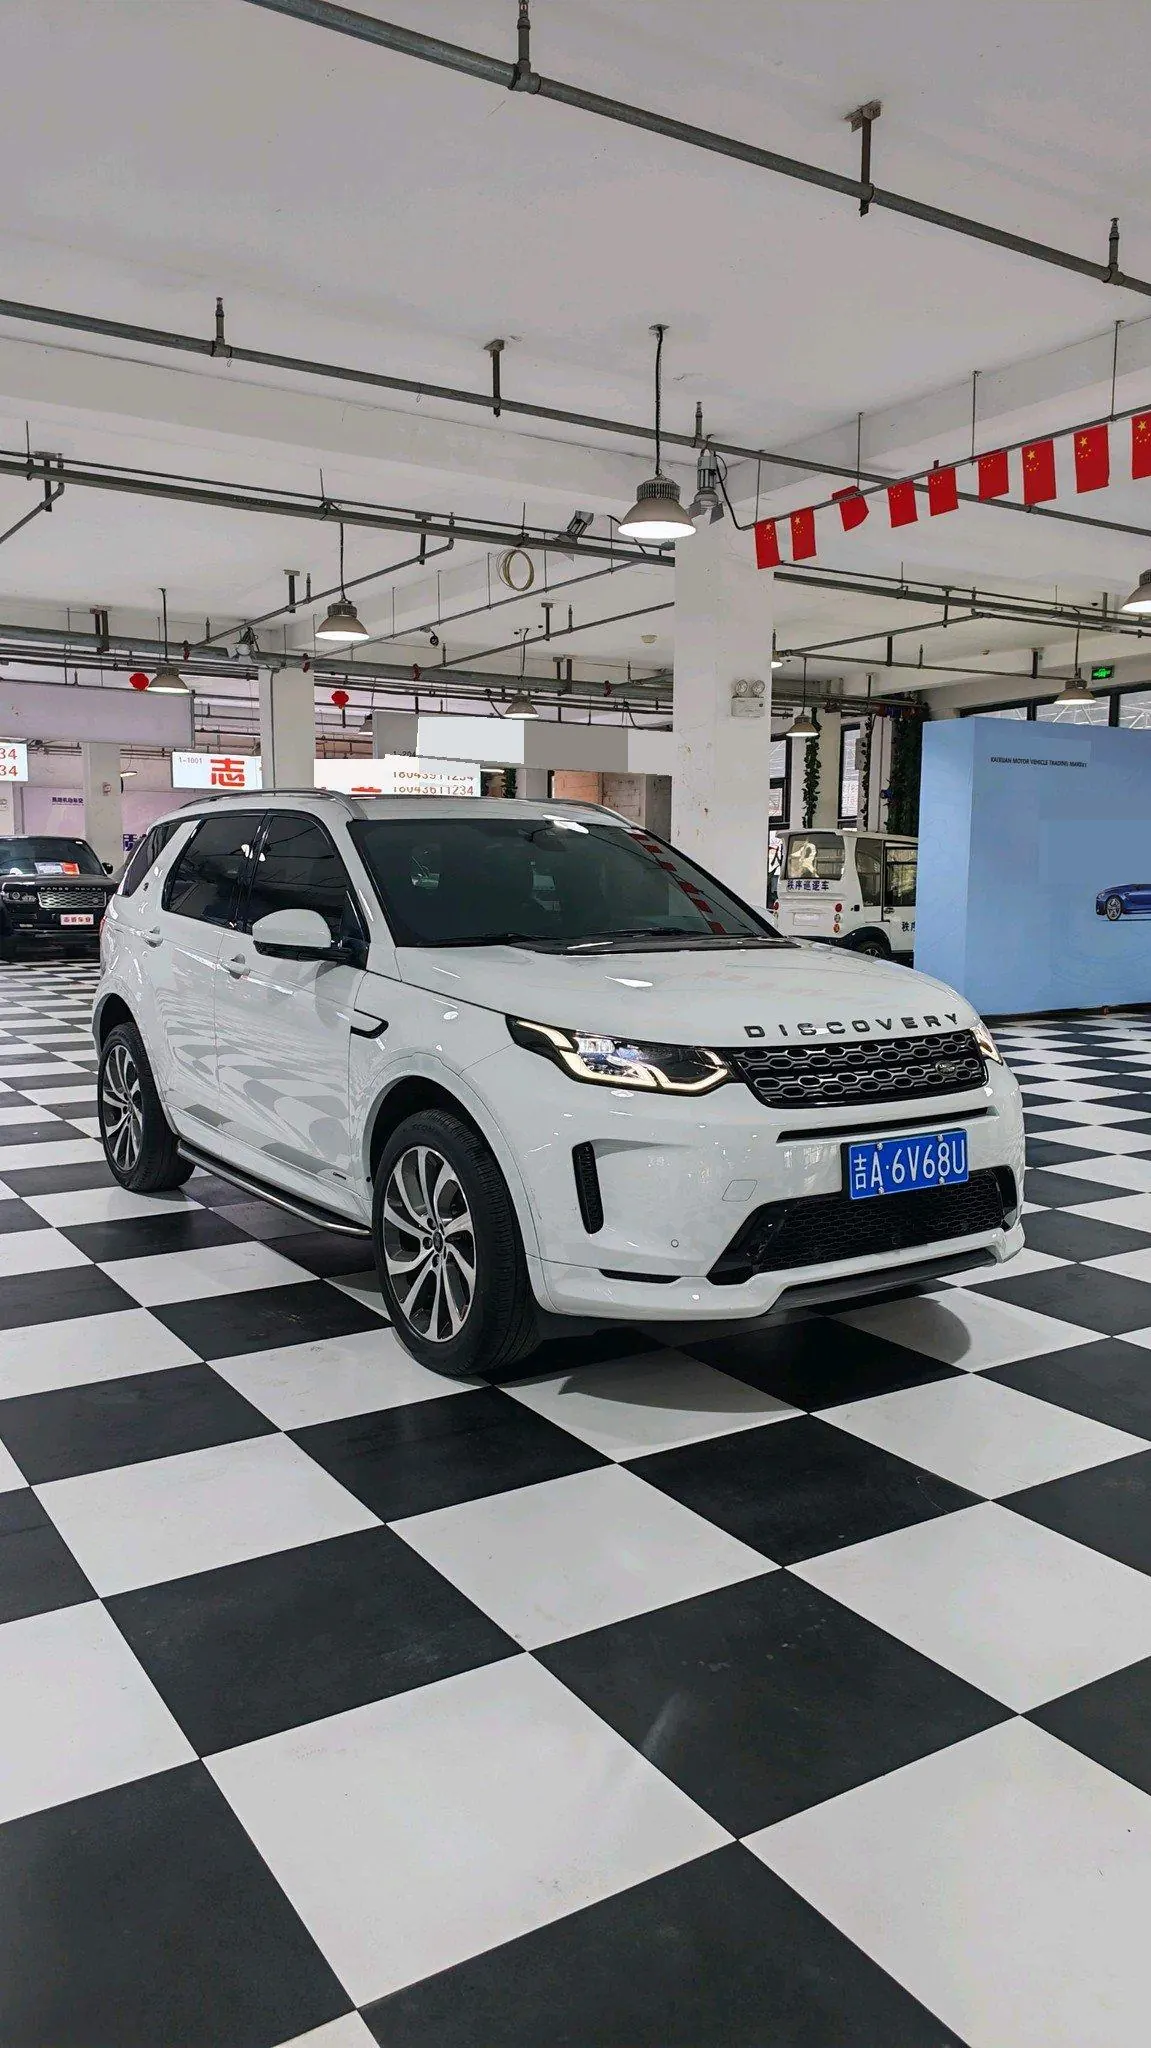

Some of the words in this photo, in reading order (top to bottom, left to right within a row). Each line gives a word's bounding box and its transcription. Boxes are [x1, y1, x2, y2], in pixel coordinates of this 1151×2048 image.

[1030, 758, 1048, 766] VEHICLE
[1049, 759, 1069, 767] TRADING
[210, 758, 245, 787] 志
[787, 879, 830, 891] 秩序巡逻车
[744, 1013, 958, 1038] DISCOVERY
